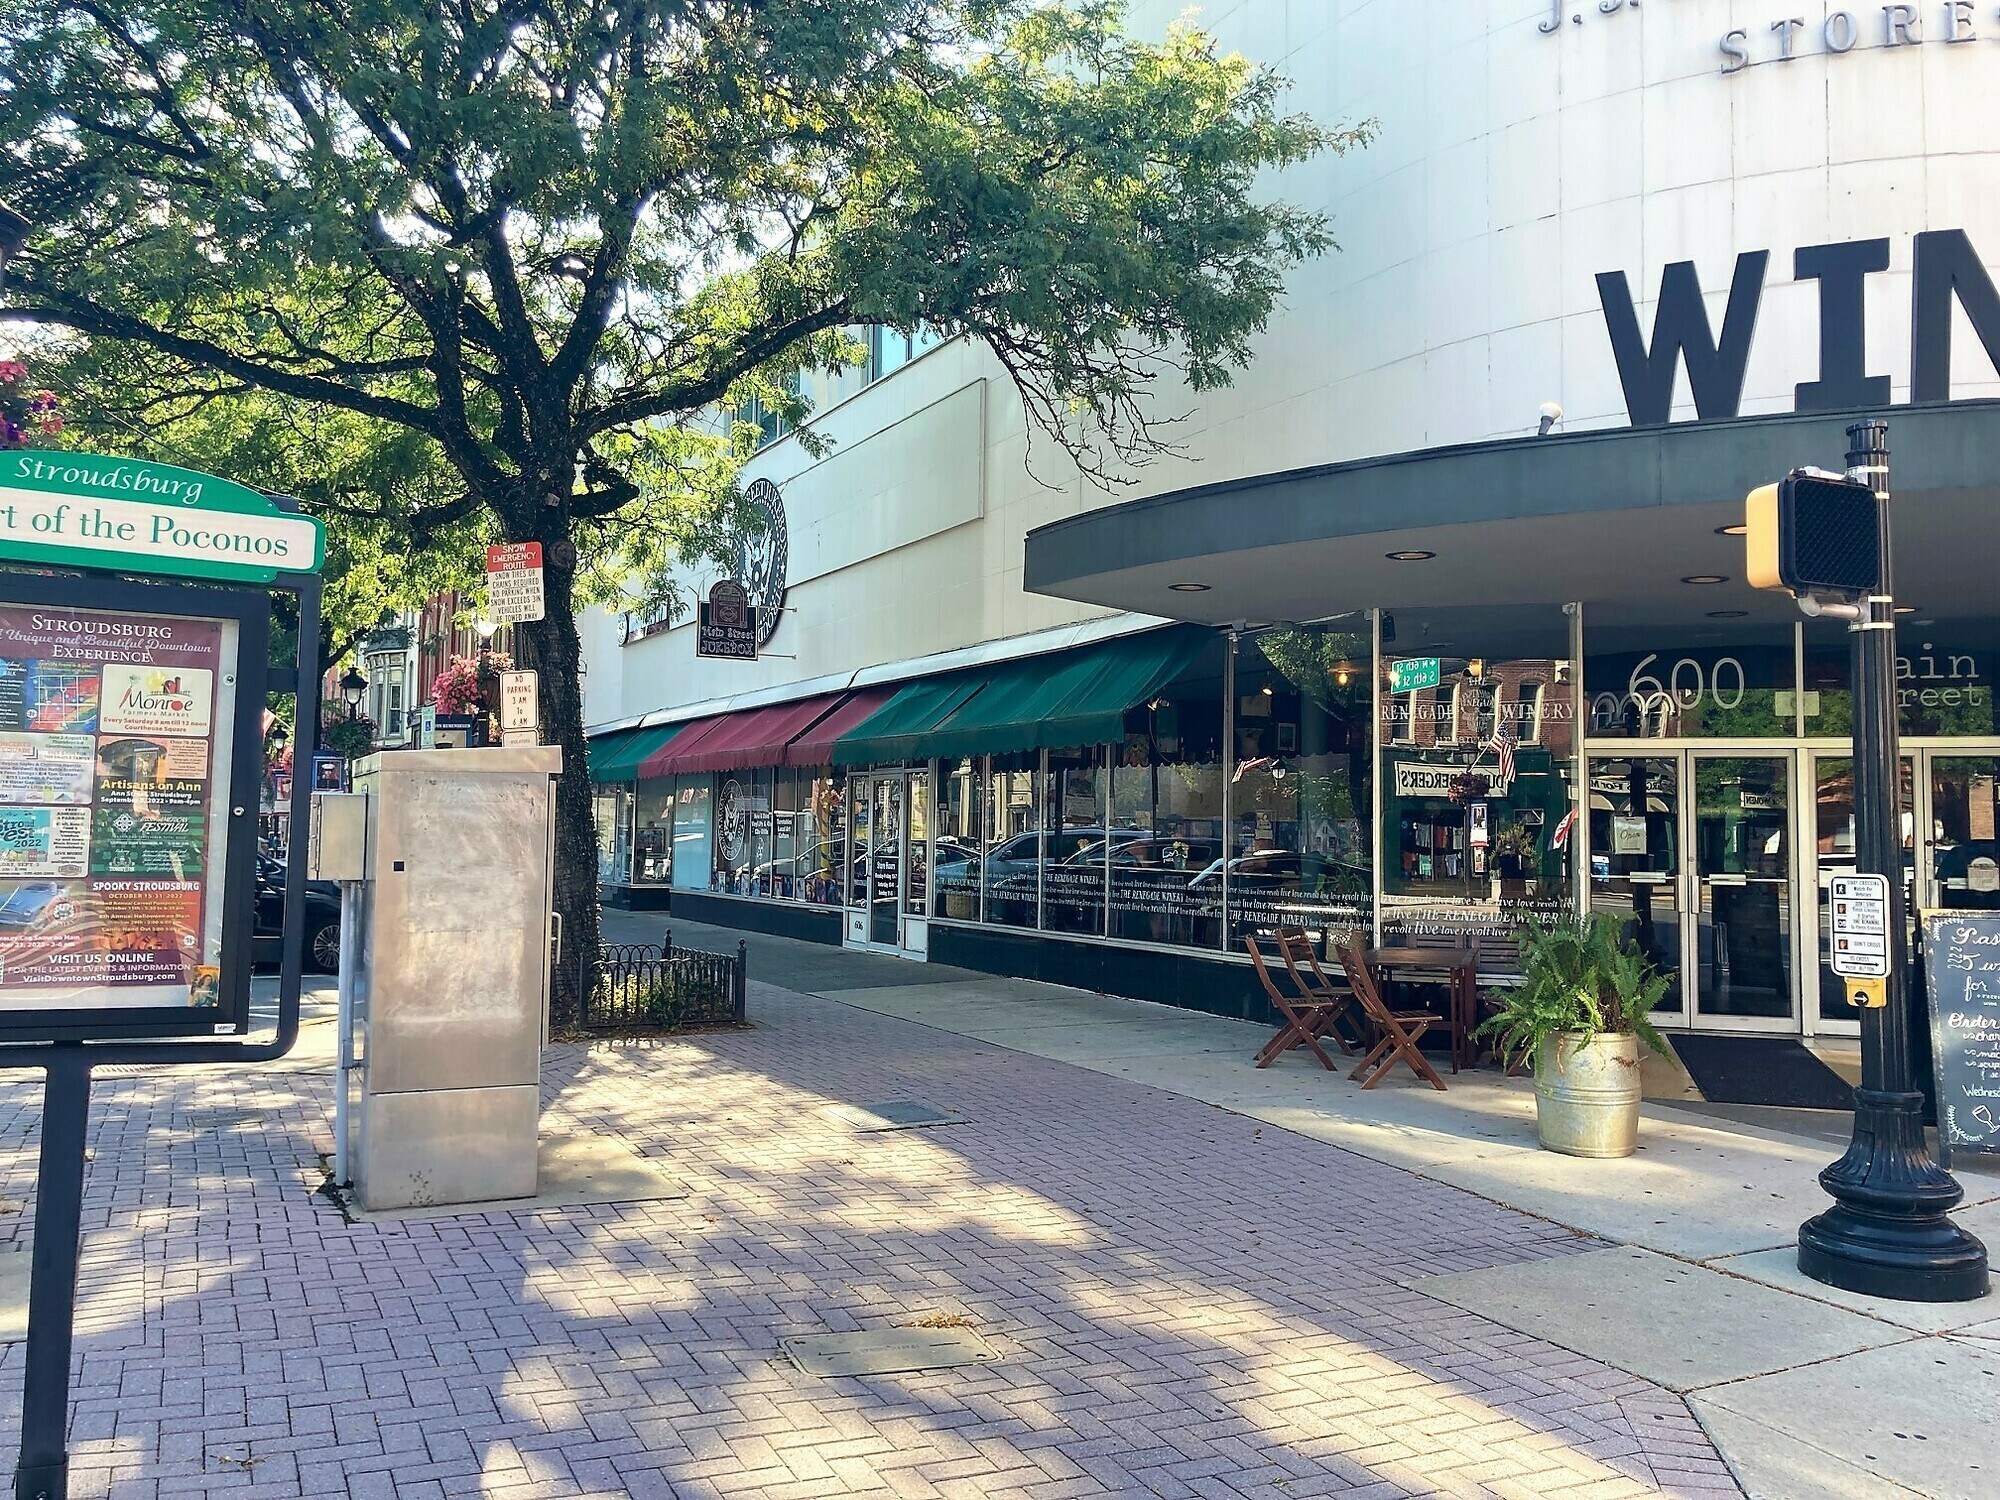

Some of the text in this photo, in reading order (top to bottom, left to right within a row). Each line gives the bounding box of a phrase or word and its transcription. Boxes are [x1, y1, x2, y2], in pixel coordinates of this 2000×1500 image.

[1719, 1, 2000, 74] STORE
[14, 457, 204, 504] Stroudsburg
[32, 505, 73, 533] of
[79, 509, 136, 541] the
[150, 514, 289, 557] Poconos
[502, 544, 527, 553] SNOW
[492, 551, 537, 563] EMERGENCY
[503, 562, 527, 570] ROUTE
[495, 569, 536, 580] SNOW TIRES OR
[492, 578, 539, 589] CHAINS REQUIRED
[492, 586, 541, 598] NO PARKING WHEN
[491, 598, 506, 607] SNOW
[507, 596, 531, 605] EXCEEDS
[497, 605, 536, 615] VEHICLES WILL
[496, 612, 538, 623] BE TOWED AWAY
[32, 614, 173, 639] STROUDSBURG
[6, 630, 212, 653] Unique and Beautiful Downtown
[52, 644, 150, 663] EXPERIENCE
[701, 640, 754, 656] JUKEBOX
[1896, 643, 1980, 680] ain
[514, 675, 524, 683] NO
[1629, 653, 1744, 710] 600
[506, 684, 532, 694] PARKING
[1900, 681, 1983, 707] reet
[122, 690, 194, 711] Monroe
[512, 696, 527, 705] 3 AM
[1381, 704, 1454, 720] RENGADE
[104, 716, 123, 725] Every
[124, 718, 154, 726] Saturday
[512, 717, 528, 726] 6 AM
[125, 723, 187, 734] Courthouse Square
[101, 779, 201, 791] Artisans on Ann
[150, 791, 192, 799] Stroudsburg
[140, 822, 190, 833] FESTIVAL
[14, 839, 42, 848] 2022
[93, 882, 199, 891] SPOOKY STROUDSBURG
[1360, 891, 1373, 902] live
[1517, 898, 1534, 908] love
[1393, 908, 1412, 920] live
[1416, 908, 1440, 921] THE
[1444, 909, 1511, 923] RENEGADE
[854, 920, 864, 931] 606
[1228, 910, 1242, 921] THE
[1243, 911, 1280, 924] RENEGADE
[1281, 913, 1309, 927] WINERY
[1384, 924, 1412, 934] revolt
[1414, 921, 1439, 935] live
[1441, 925, 1460, 935] love
[1460, 926, 1492, 936] revolt
[48, 953, 154, 964] VISIT US ONLINE
[8, 966, 27, 974] FOR
[128, 963, 191, 972] INFORMATION
[23, 973, 176, 983] VisitDowntownStroudsburg.com
[1964, 975, 1988, 1002] for
